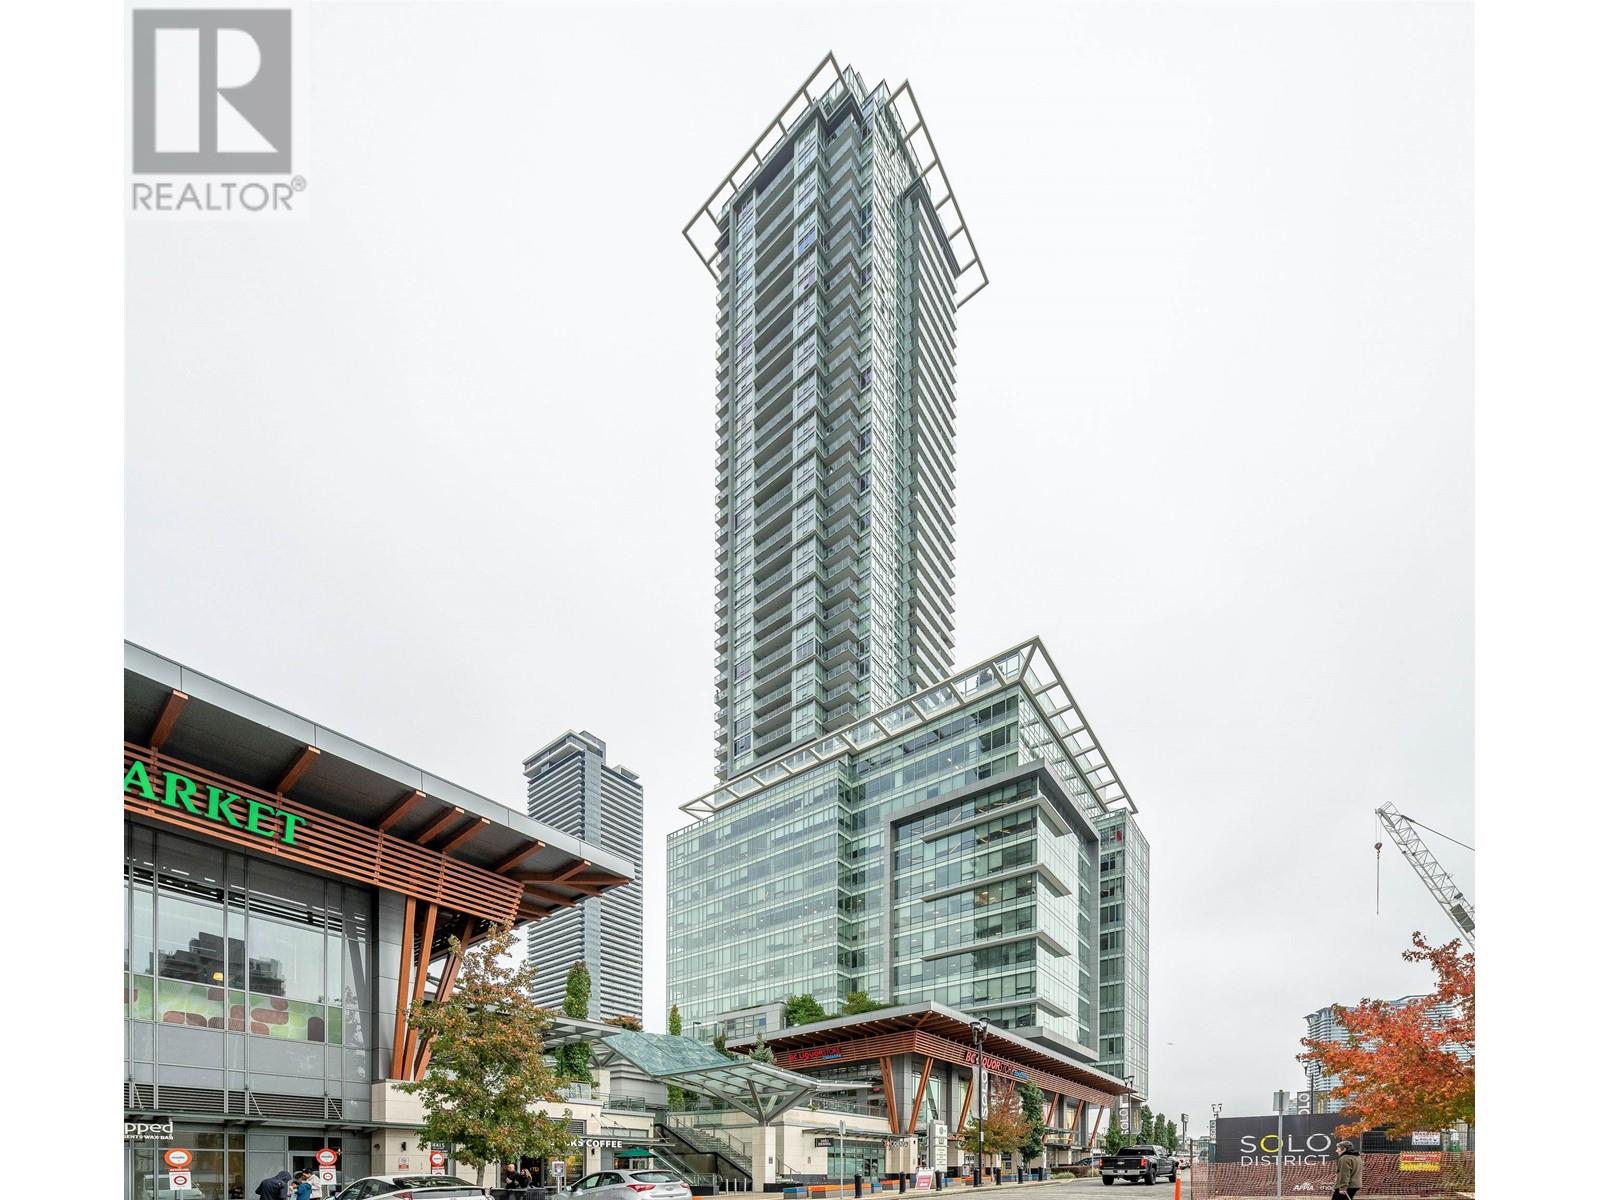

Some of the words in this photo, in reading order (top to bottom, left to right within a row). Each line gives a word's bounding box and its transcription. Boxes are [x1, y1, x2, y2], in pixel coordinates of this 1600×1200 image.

[966, 1051, 977, 1064] BC
[1298, 1093, 1310, 1115] OLO
[124, 1121, 174, 1135] pped
[585, 1139, 622, 1148] COFFEE
[1240, 1133, 1331, 1153] SOLO
[1241, 1154, 1330, 1167] DISTRICT
